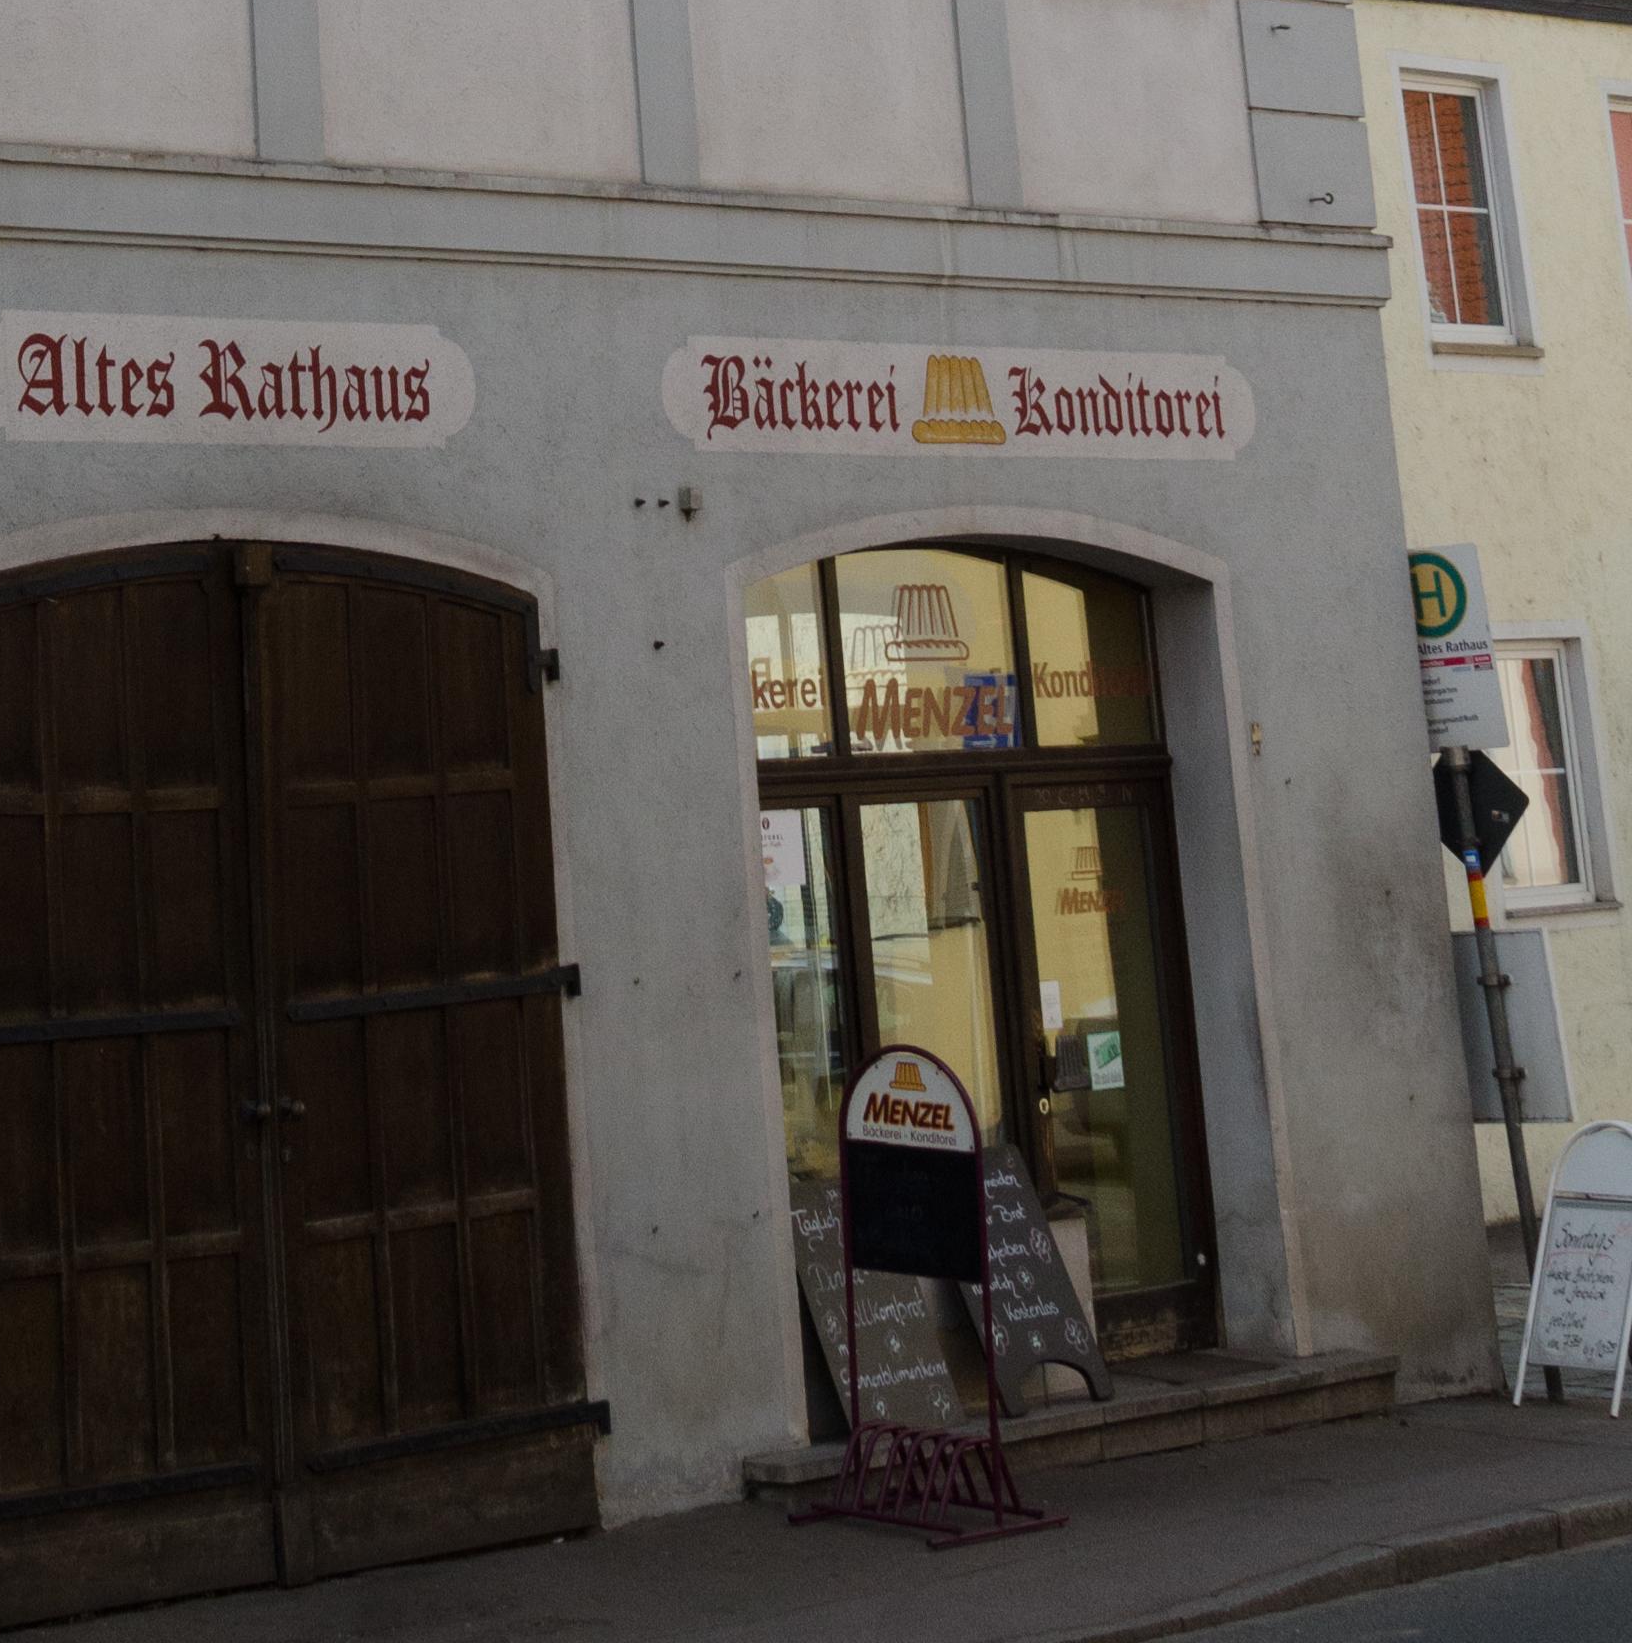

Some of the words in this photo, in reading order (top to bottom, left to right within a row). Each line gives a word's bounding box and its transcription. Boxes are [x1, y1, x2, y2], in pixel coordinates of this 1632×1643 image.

[17, 332, 176, 418] Altes
[198, 338, 431, 434] Rathaus
[701, 354, 901, 441] Bäckerei
[1008, 366, 1226, 440] Konditorei
[1445, 639, 1489, 653] Rathaus
[752, 669, 825, 710] kerei
[855, 677, 1014, 741] MENZEL
[863, 1092, 955, 1132] MENZEL
[910, 1130, 957, 1147] Konditorei
